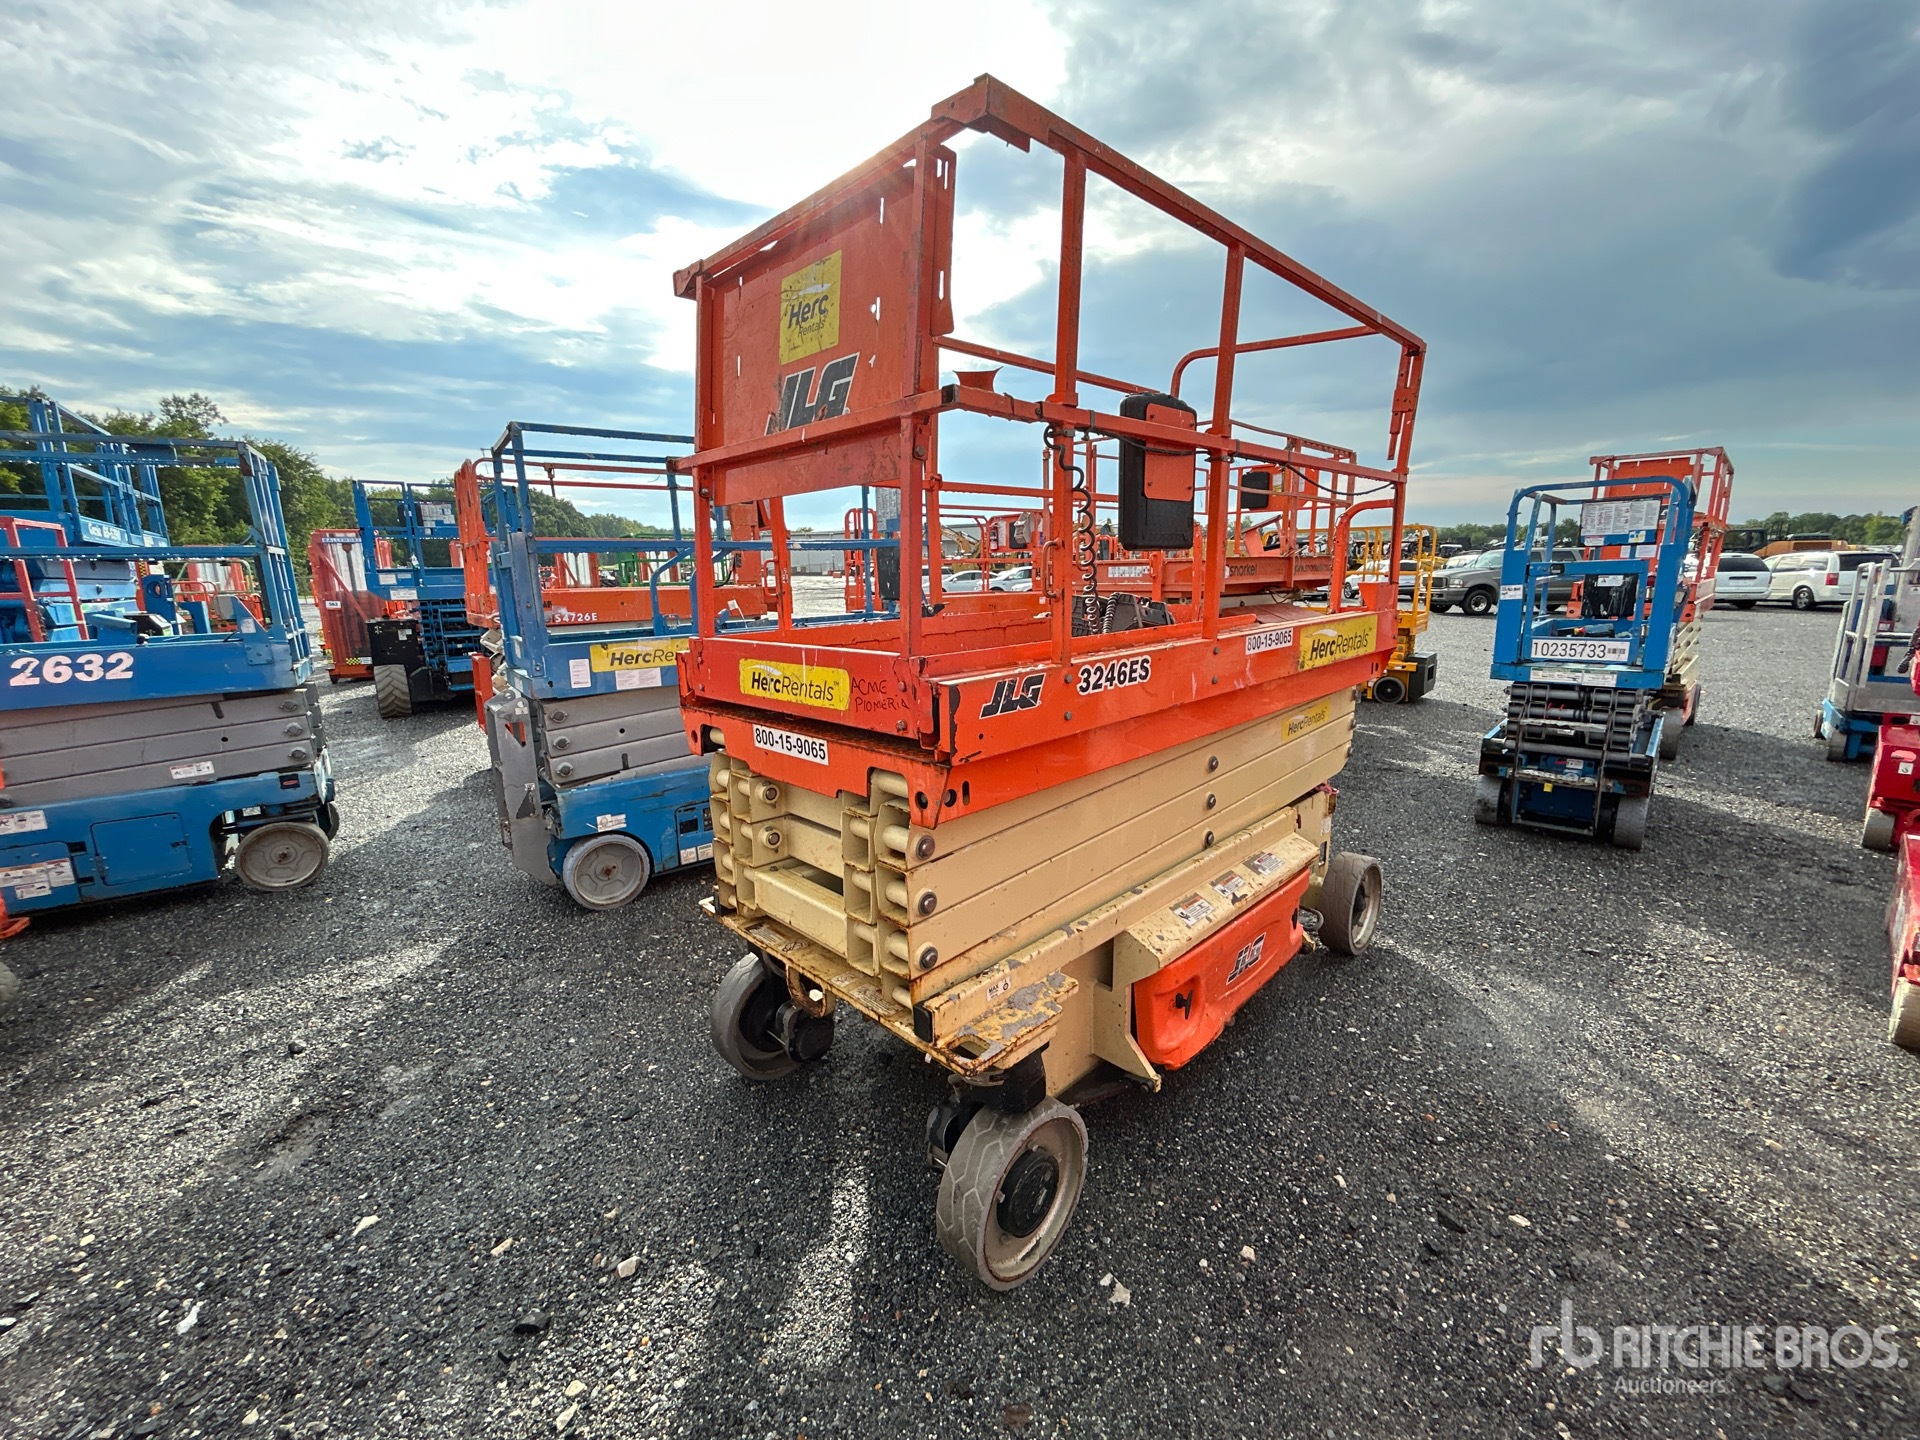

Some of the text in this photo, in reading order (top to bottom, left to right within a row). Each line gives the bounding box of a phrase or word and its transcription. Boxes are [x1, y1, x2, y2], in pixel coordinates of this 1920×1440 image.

[788, 294, 829, 329] Herc
[798, 320, 826, 338] Rentals
[764, 352, 860, 437] JLG
[1229, 563, 1257, 577] snorkel
[1246, 629, 1292, 652] 800-15-9065
[1532, 641, 1607, 659] 10235733
[9, 651, 134, 687] 2632
[851, 676, 887, 695] ACME
[1077, 656, 1151, 695] 3246ES
[979, 672, 1047, 720] JLG
[755, 727, 826, 760] 800-15-9065
[1226, 932, 1266, 986] JLG
